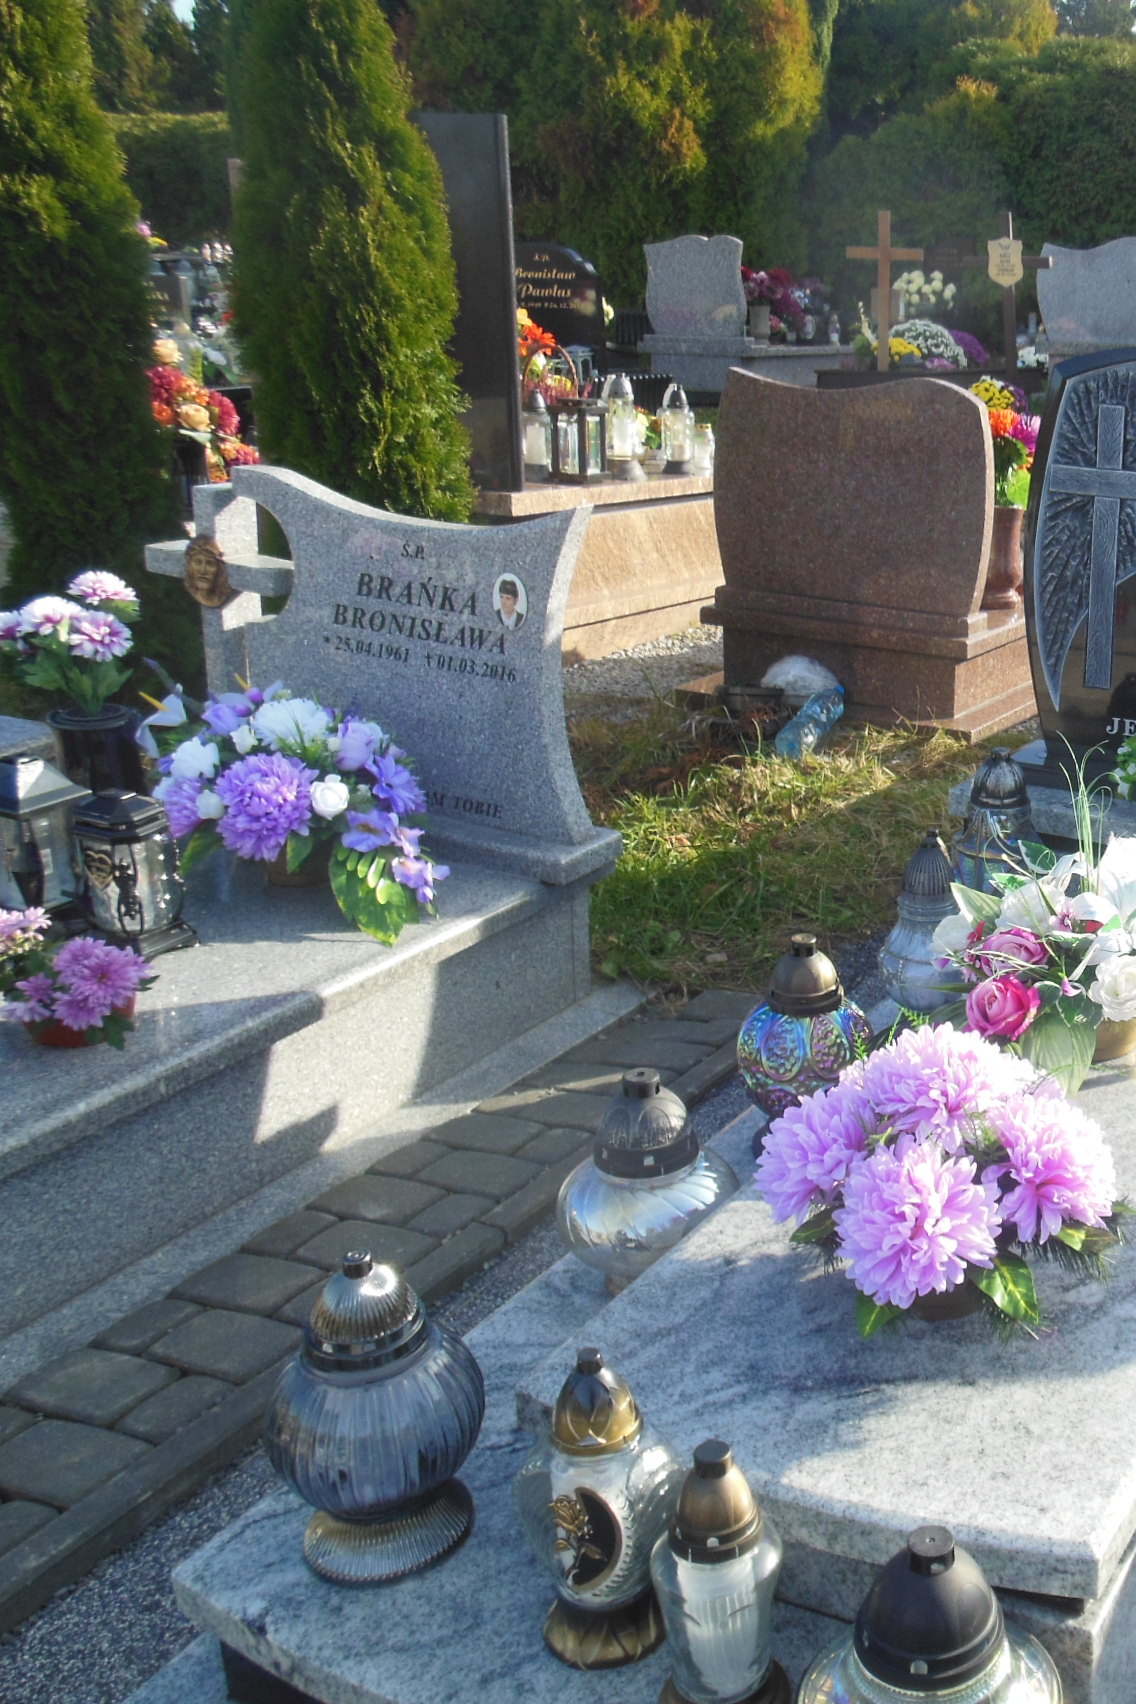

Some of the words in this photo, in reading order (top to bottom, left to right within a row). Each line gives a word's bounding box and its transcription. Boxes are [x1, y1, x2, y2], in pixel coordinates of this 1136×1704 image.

[355, 572, 478, 616] BRAŃKA
[332, 604, 507, 655] BRONISŁAWA
[334, 636, 410, 663] 25.04.1961
[437, 655, 517, 683] 01.03.2016
[453, 796, 504, 819] TOBIE
